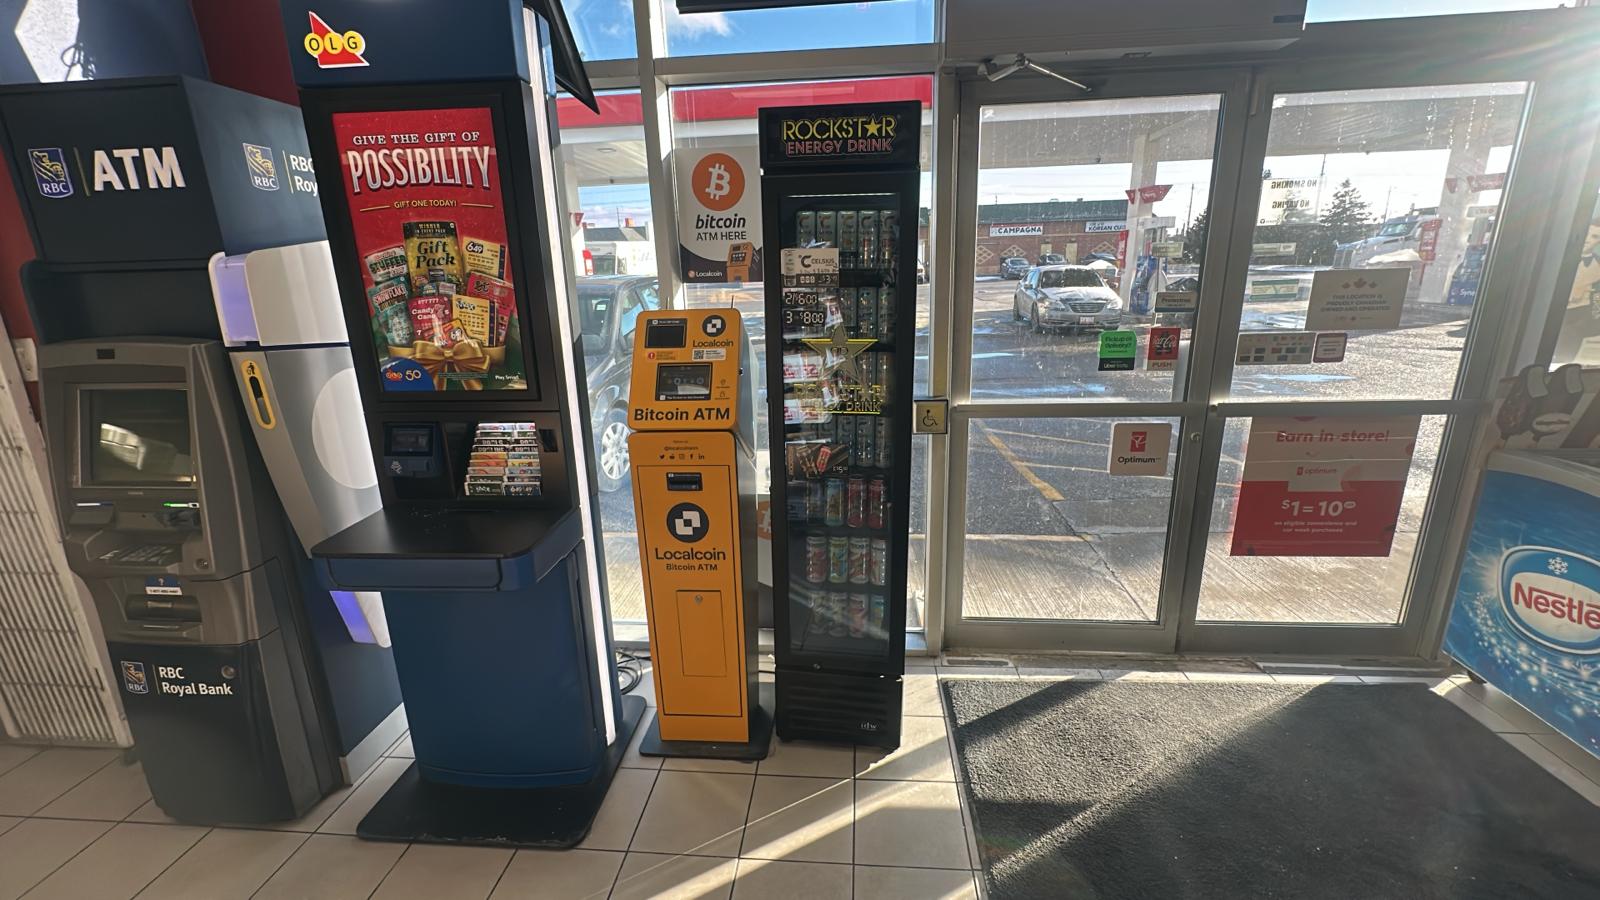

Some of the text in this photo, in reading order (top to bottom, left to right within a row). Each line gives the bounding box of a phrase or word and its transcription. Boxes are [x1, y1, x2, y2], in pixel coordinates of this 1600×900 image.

[308, 35, 358, 51] OLG
[353, 131, 480, 145] GIVE THE GIFT OF
[788, 138, 892, 154] ENERGY DRINK
[93, 146, 186, 192] ATM
[346, 145, 490, 193] POSSIBILITY
[42, 182, 68, 194] RBC
[254, 176, 276, 189] RBC
[429, 199, 457, 207] TODAY!
[695, 213, 747, 229] bitcoin
[696, 231, 747, 241] ATM HERE
[998, 227, 1042, 235] CAMPAGNA
[417, 240, 448, 255] Gift
[416, 254, 456, 269] Pack
[786, 312, 793, 324] 3
[692, 340, 734, 348] Localcoin
[405, 369, 422, 381] 50
[846, 401, 880, 412] DRINK
[634, 407, 730, 421] Bitcoin ATM
[1275, 430, 1313, 443] Earn
[1118, 456, 1156, 464] Optimum
[1281, 500, 1299, 516] $1
[1319, 501, 1343, 516] 10
[655, 547, 726, 560] Localcoin
[666, 563, 718, 571] Bitcoin ATM
[158, 666, 185, 679] RBC
[128, 683, 146, 692] RBC
[161, 681, 233, 697] Royal Bank
